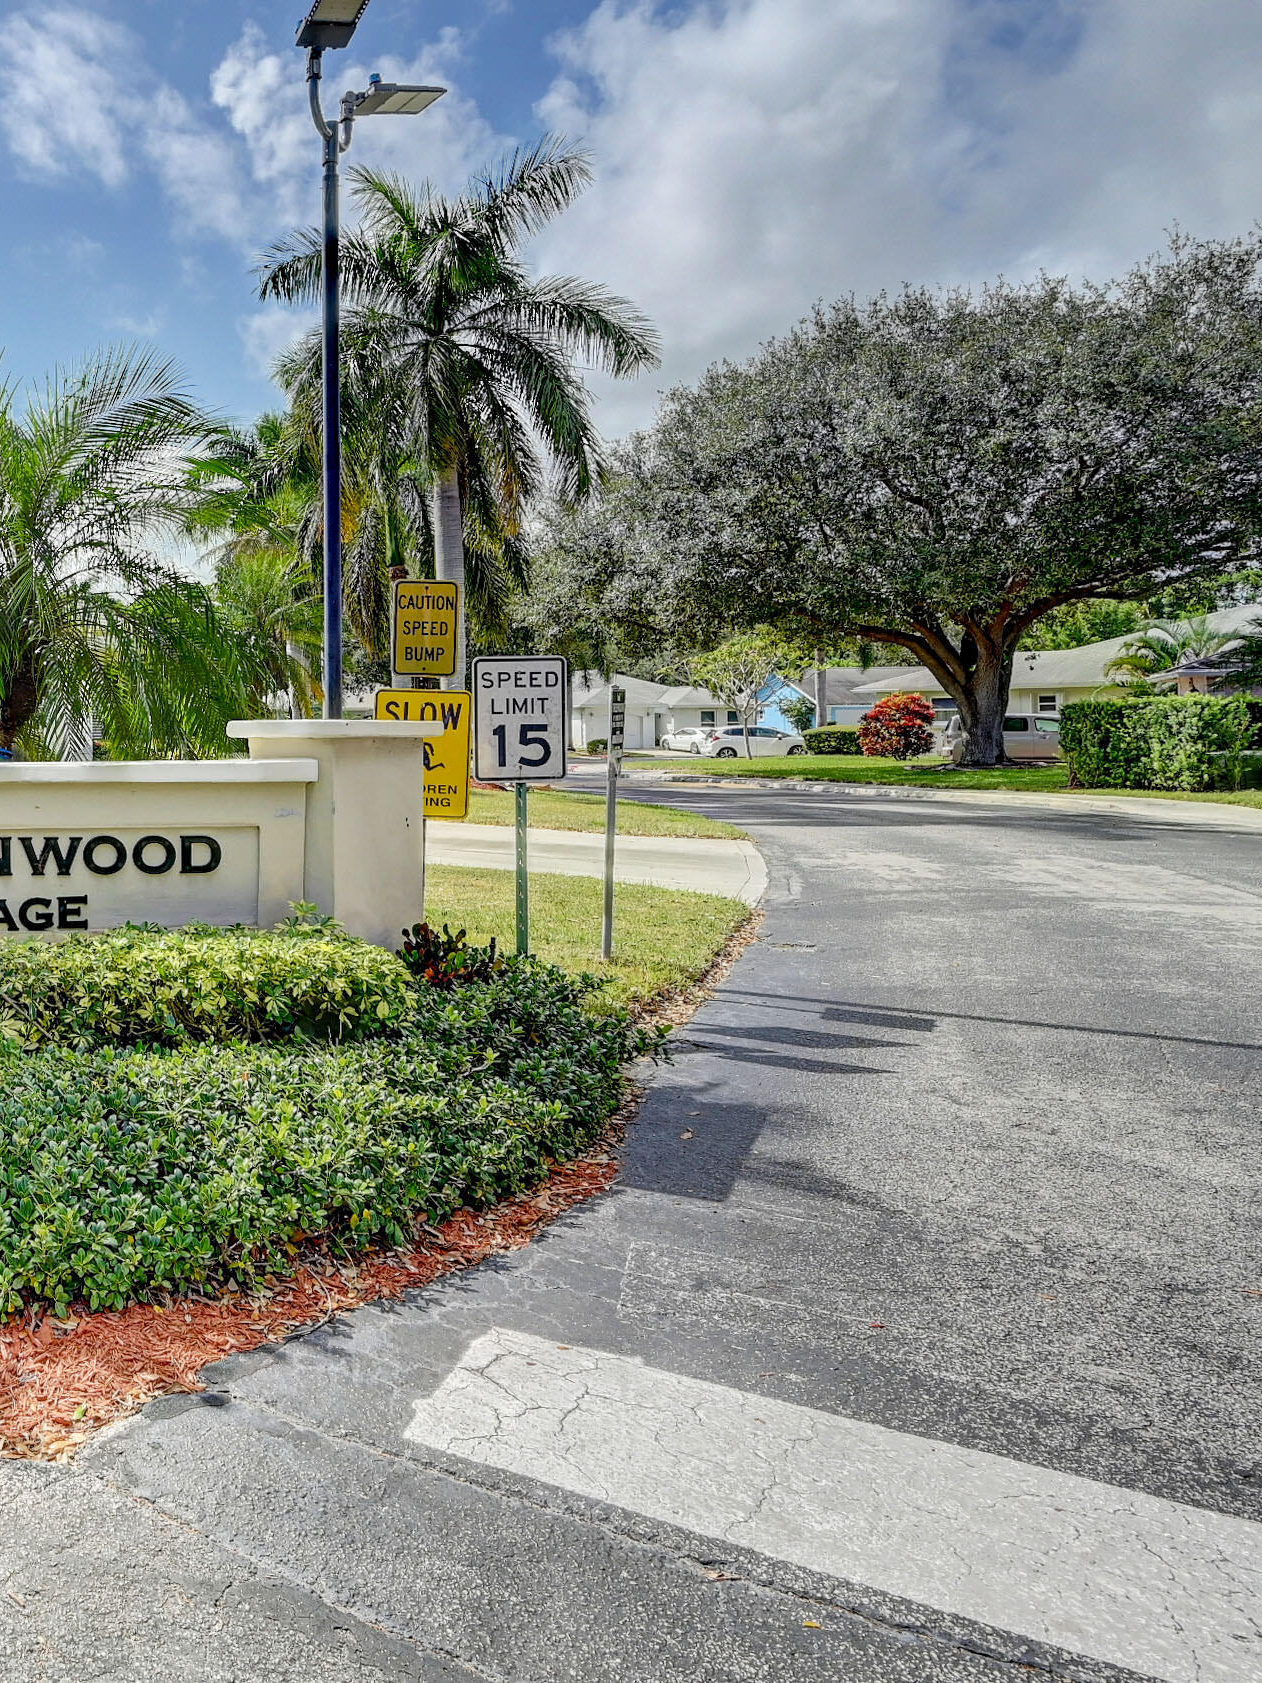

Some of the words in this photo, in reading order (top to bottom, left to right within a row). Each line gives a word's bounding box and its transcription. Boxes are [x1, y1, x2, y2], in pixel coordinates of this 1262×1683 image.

[398, 594, 454, 610] CAUTION
[402, 620, 448, 636] SPEED
[404, 646, 445, 661] BUMP
[481, 671, 559, 688] SPEED
[491, 697, 549, 715] LIMIT
[492, 724, 552, 768] 15
